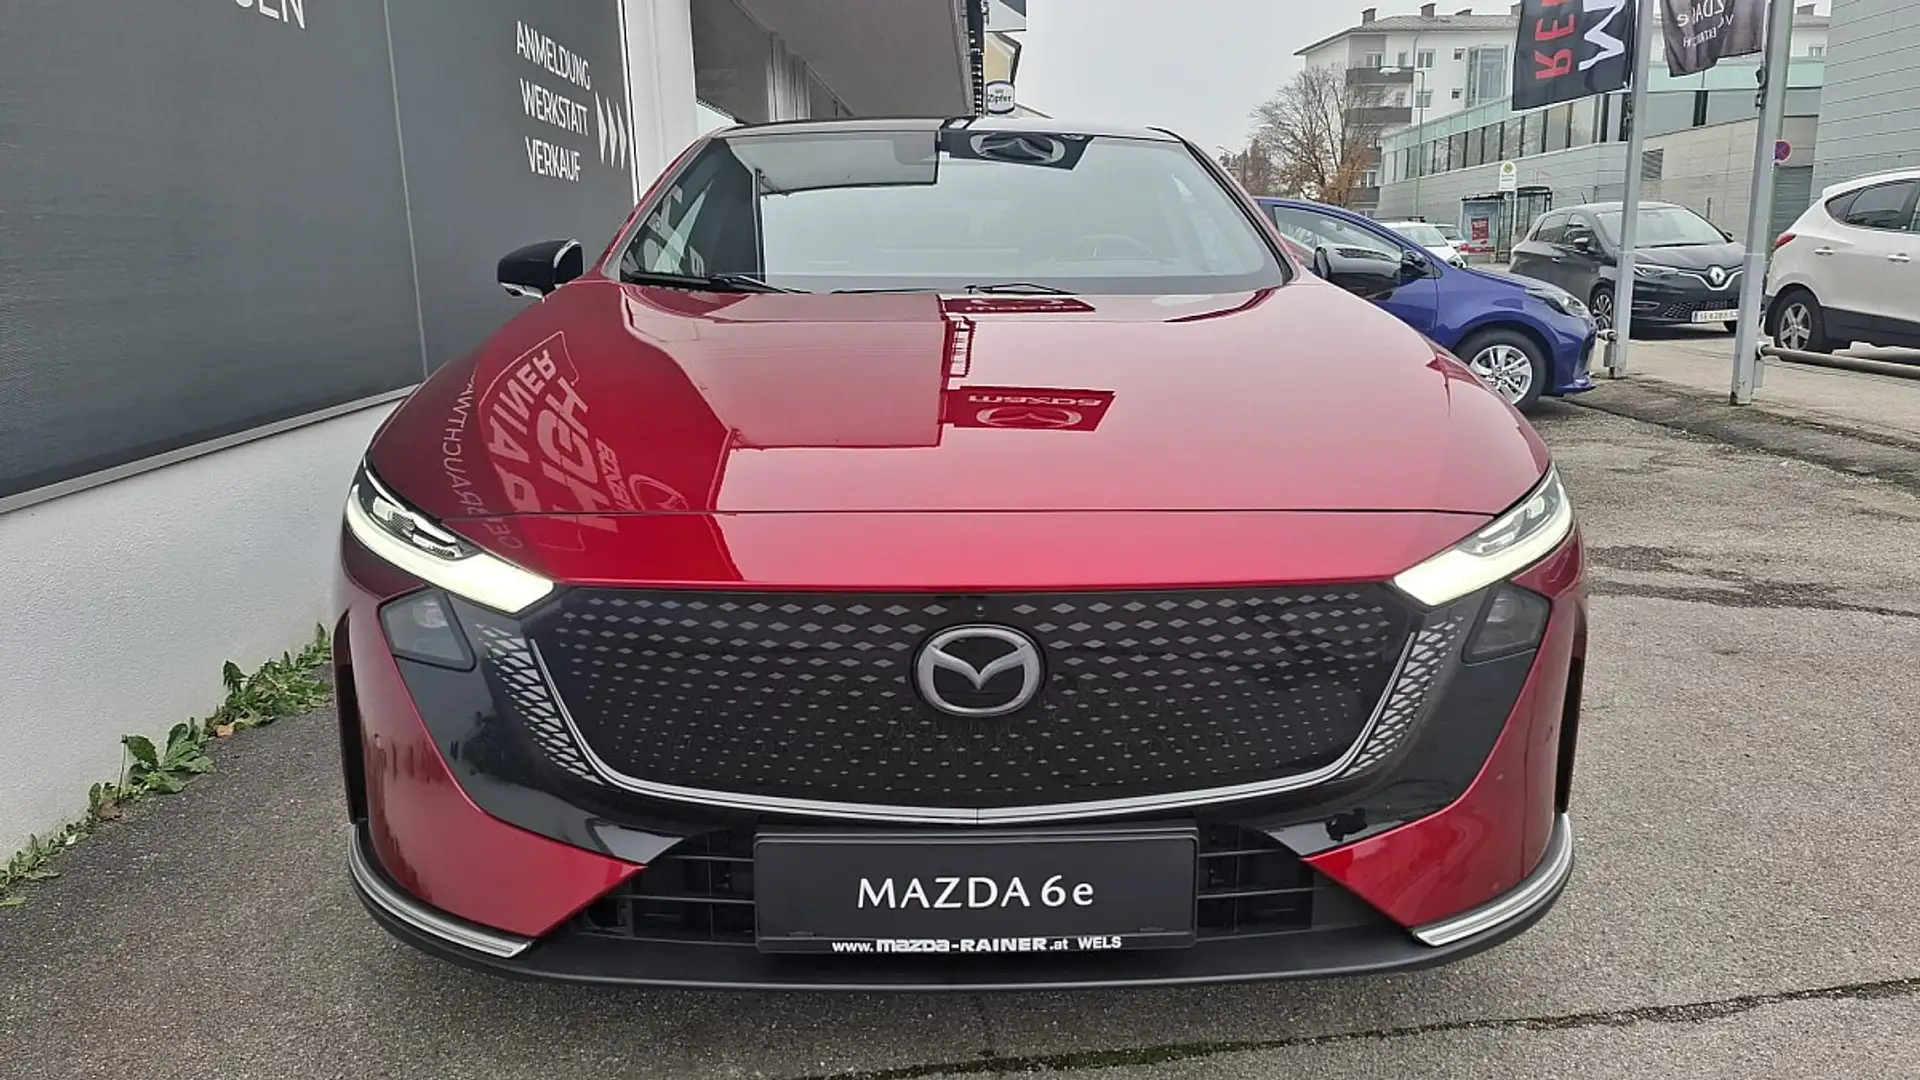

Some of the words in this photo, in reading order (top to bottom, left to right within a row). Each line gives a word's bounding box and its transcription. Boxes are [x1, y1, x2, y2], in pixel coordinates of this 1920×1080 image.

[516, 20, 591, 91] ANMELDUNG
[520, 78, 589, 137] WERKSTATT
[525, 136, 581, 182] VERKAUF
[857, 876, 1031, 909] MAZDA
[1041, 875, 1094, 906] 6e
[1077, 936, 1122, 950] WELS
